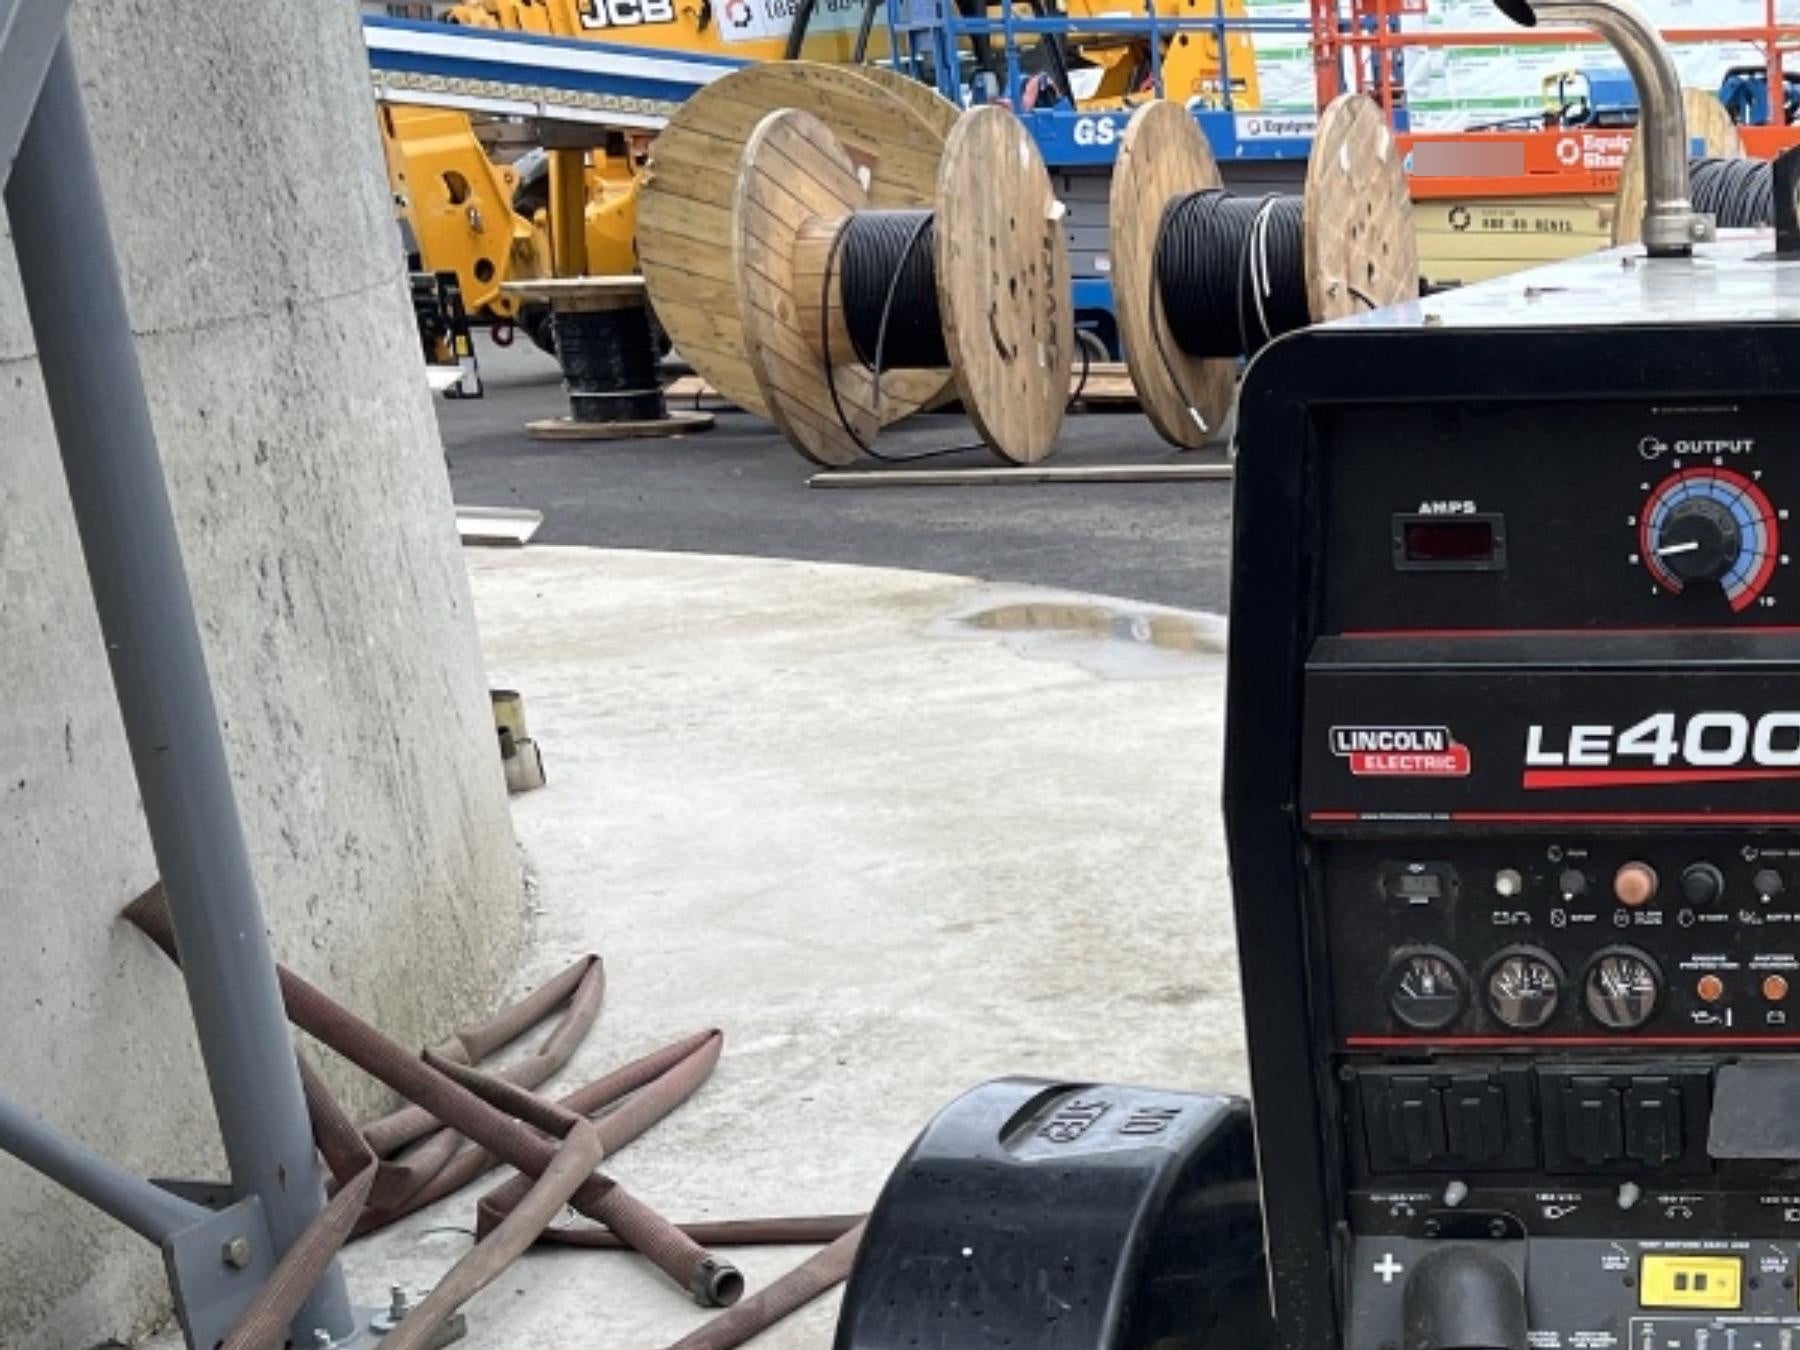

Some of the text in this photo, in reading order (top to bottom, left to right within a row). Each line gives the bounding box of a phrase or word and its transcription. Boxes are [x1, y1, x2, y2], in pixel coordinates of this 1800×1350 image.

[1674, 440, 1754, 454] OUTPUT
[1418, 500, 1477, 514] AMPS
[1337, 731, 1443, 751] LINCOLN
[1364, 756, 1457, 771] ELECTRIC
